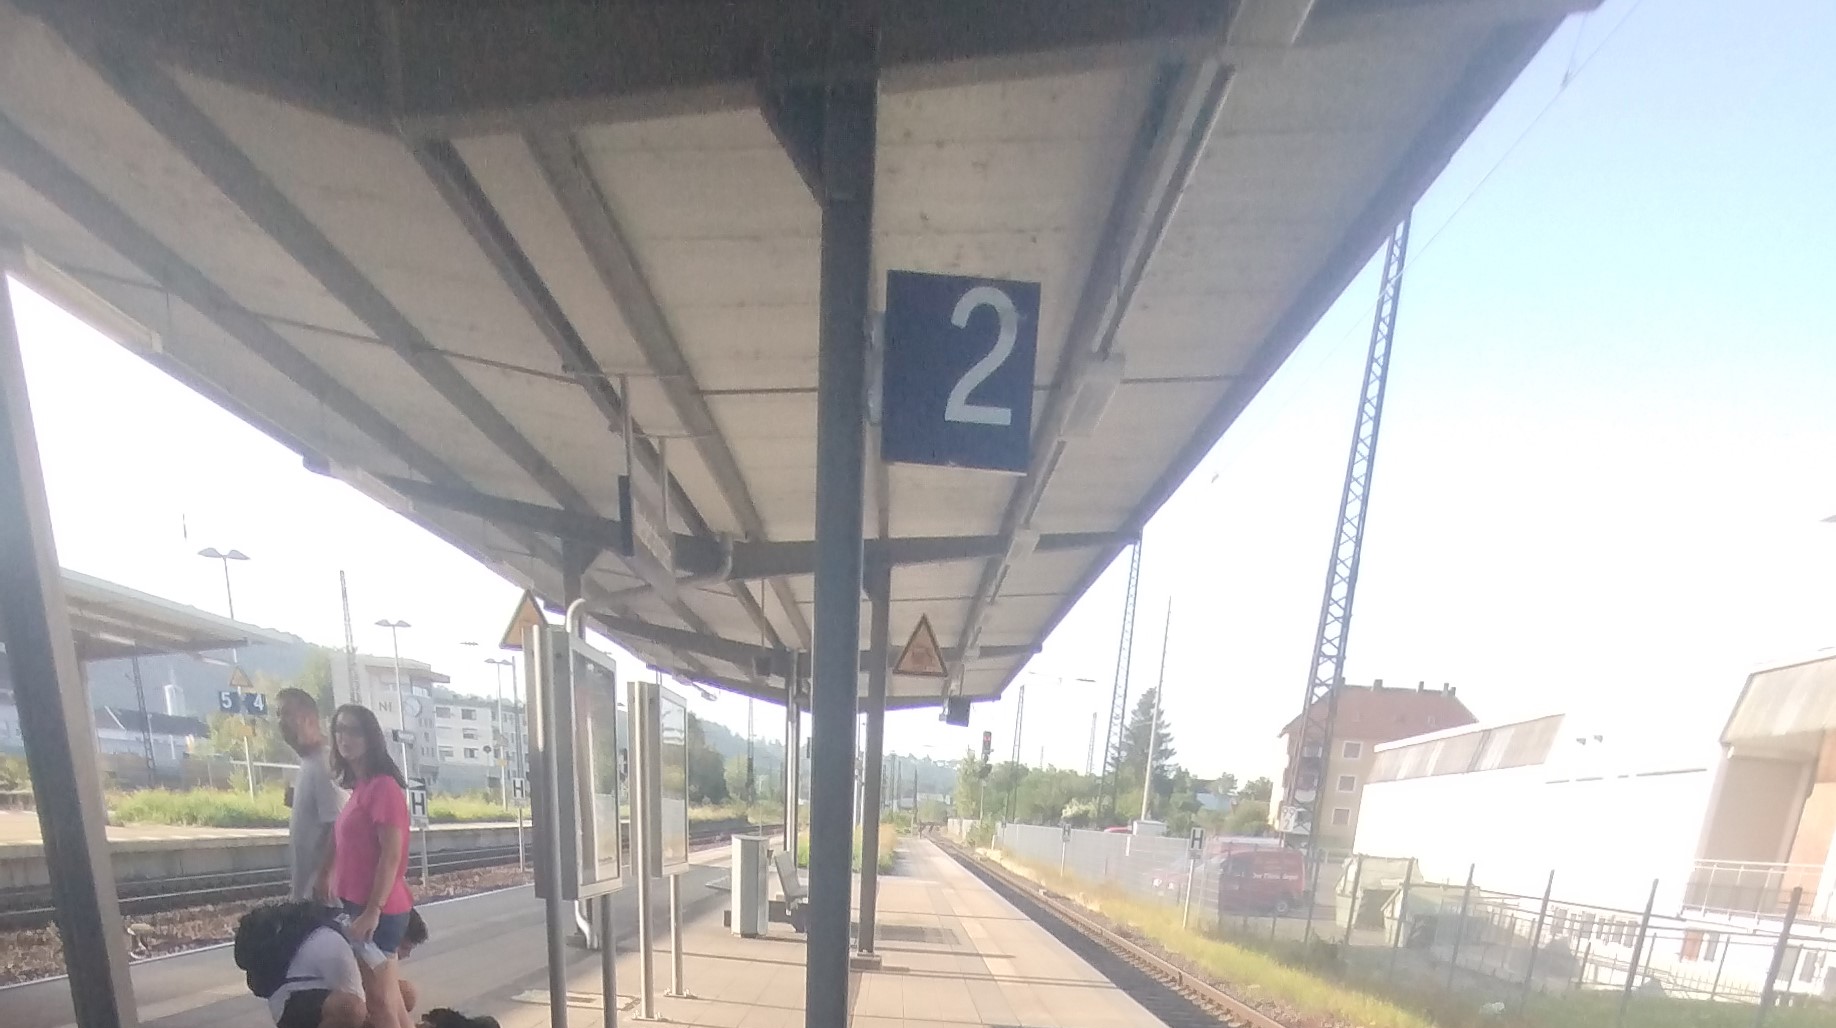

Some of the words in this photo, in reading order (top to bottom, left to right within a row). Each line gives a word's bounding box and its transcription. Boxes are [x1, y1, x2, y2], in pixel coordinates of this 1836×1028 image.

[944, 286, 1018, 426] 2
[221, 691, 233, 709] 5
[253, 693, 265, 711] 4
[513, 779, 524, 798] H
[411, 791, 426, 815] H
[1190, 829, 1204, 850] H
